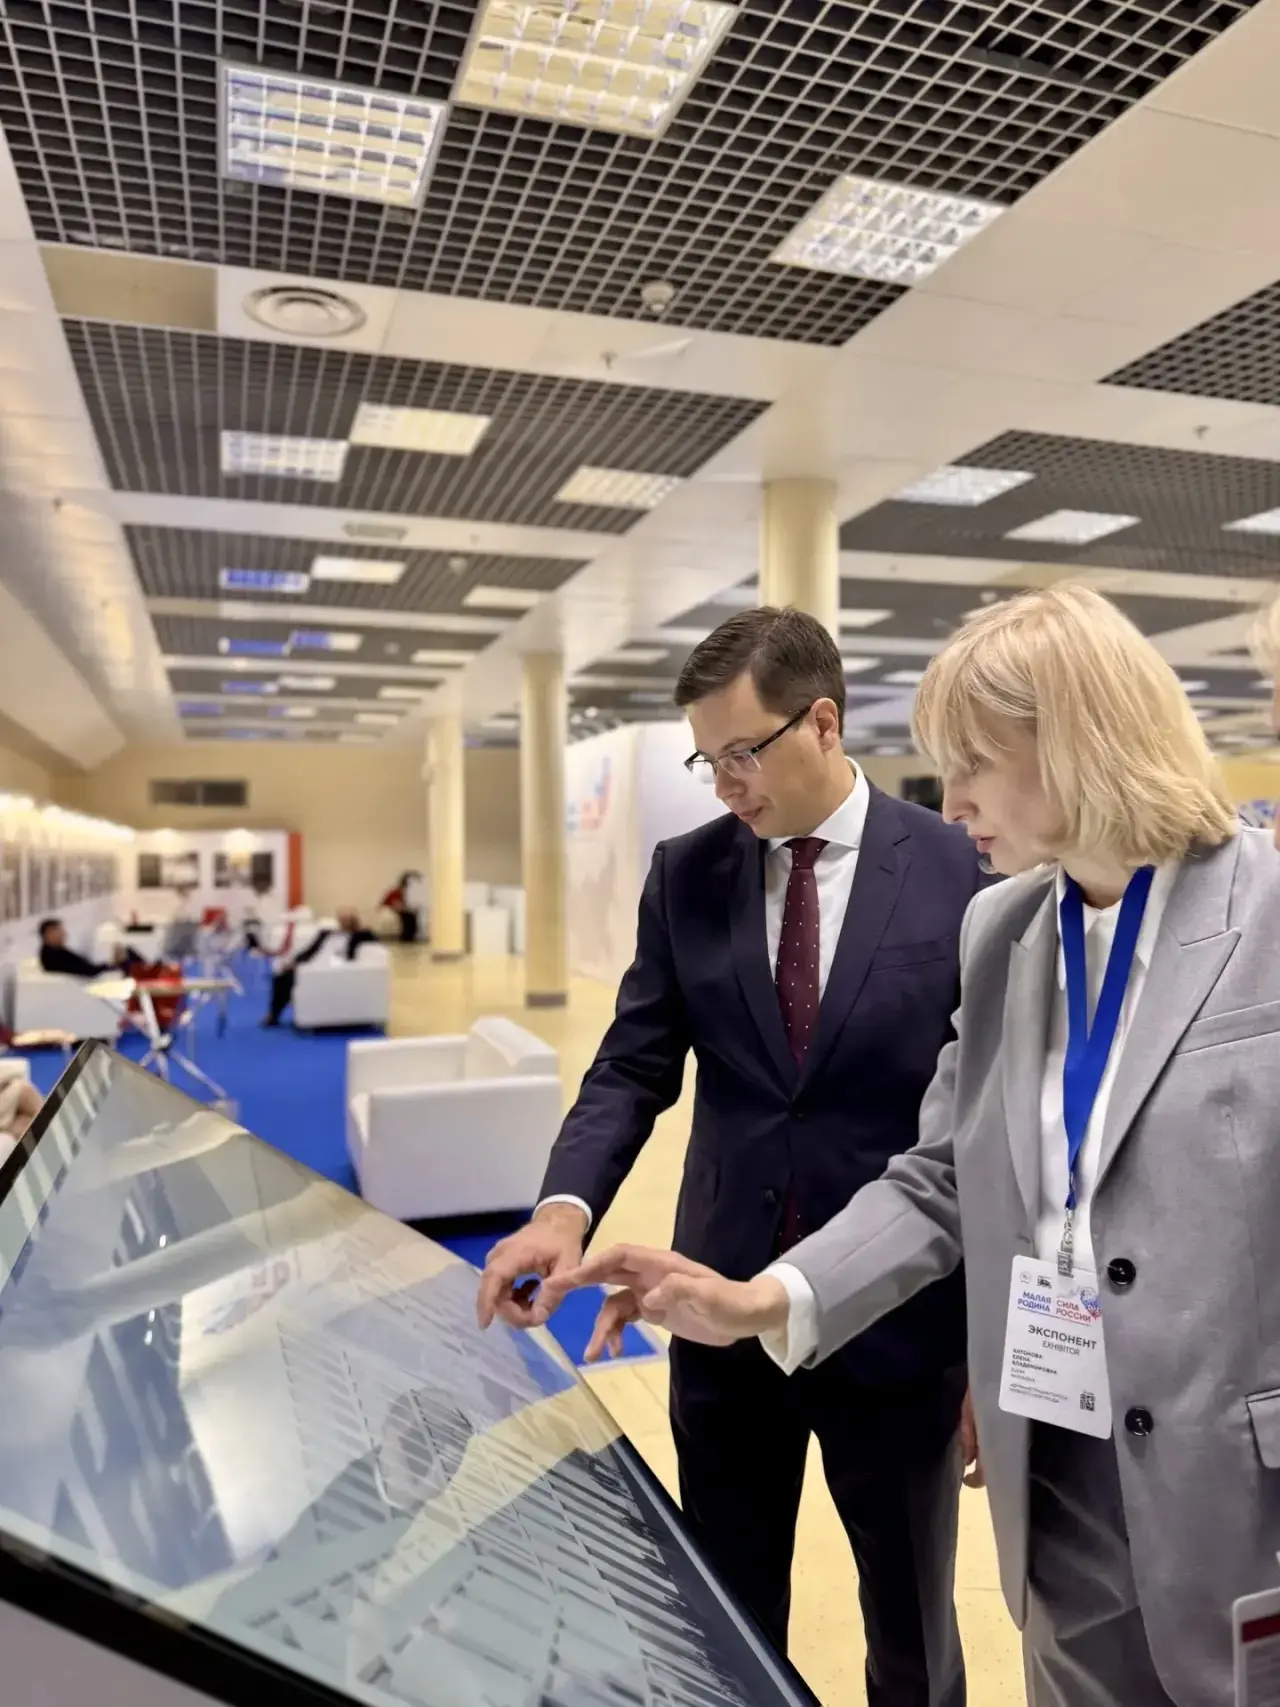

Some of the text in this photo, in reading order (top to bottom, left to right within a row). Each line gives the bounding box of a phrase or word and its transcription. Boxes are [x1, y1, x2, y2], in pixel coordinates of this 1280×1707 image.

[1022, 1291, 1052, 1304] МАЛАЯ
[1017, 1298, 1051, 1312] РОДИНА
[1056, 1299, 1080, 1311] СИЛА
[1055, 1308, 1091, 1322] РОССИИ
[1027, 1324, 1097, 1349] ЭКСПОНЕНТ
[1042, 1340, 1081, 1356] EXHIBITOR
